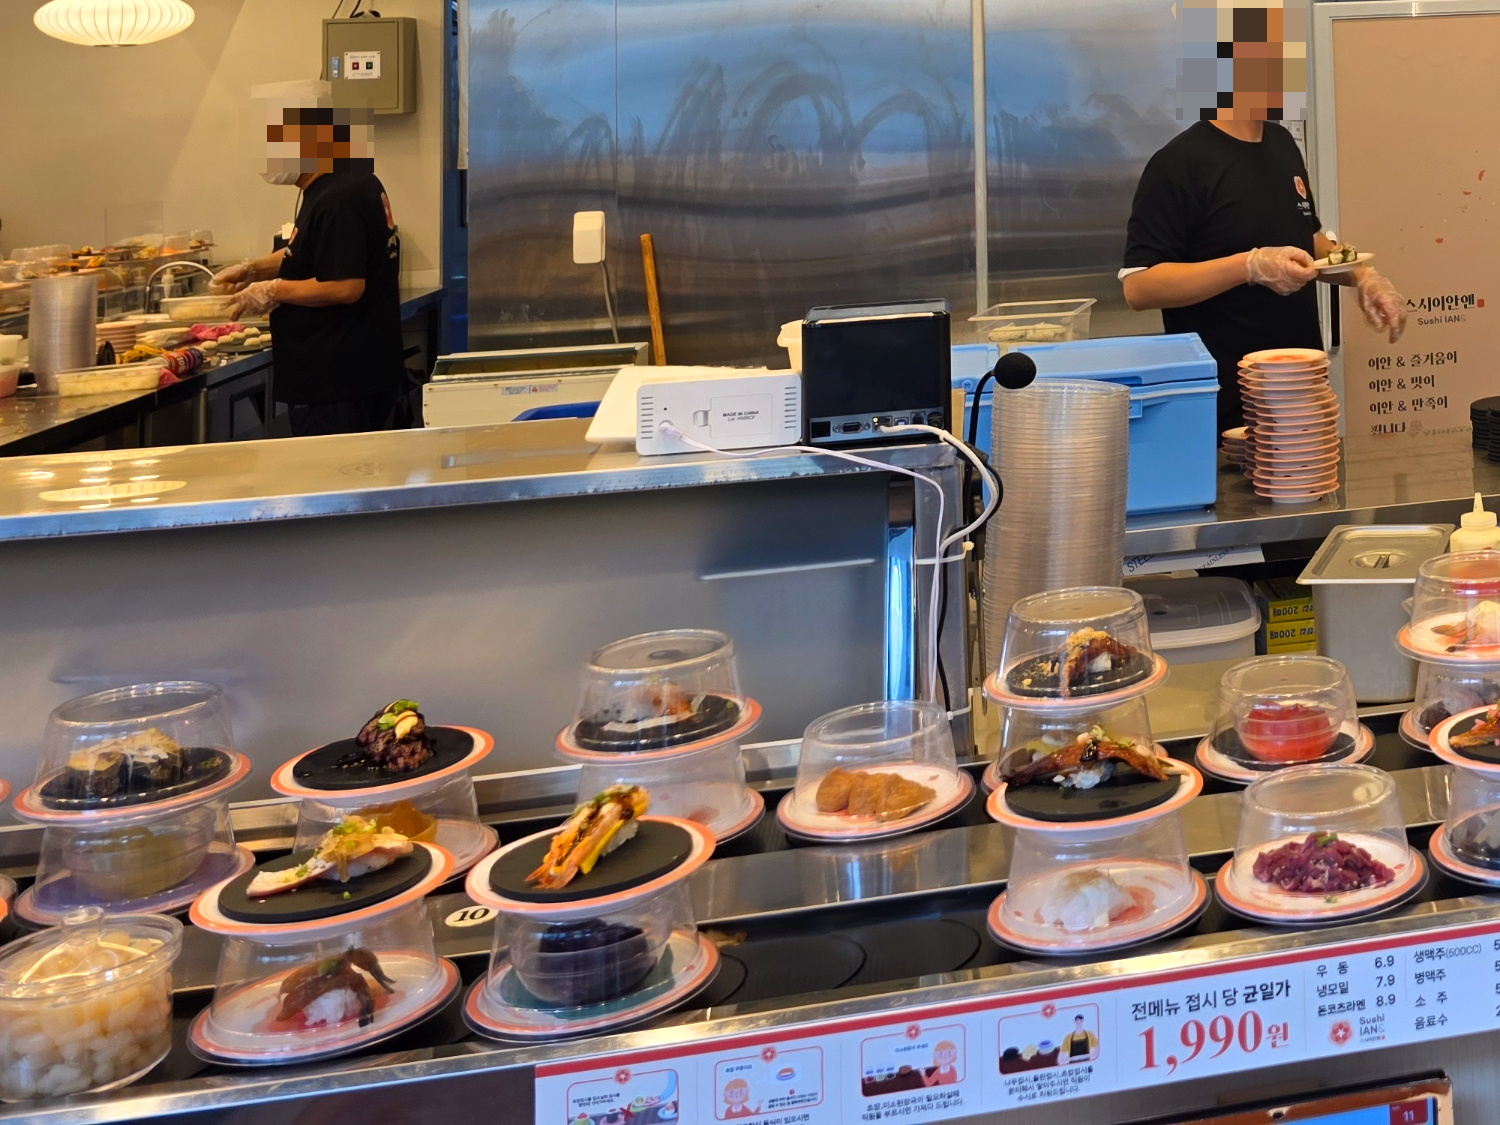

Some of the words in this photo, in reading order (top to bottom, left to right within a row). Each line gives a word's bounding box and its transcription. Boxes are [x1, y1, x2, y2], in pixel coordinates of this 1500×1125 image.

[1406, 293, 1476, 313] 스시이안앤
[1417, 315, 1443, 326] Sushi
[1368, 356, 1392, 371] 이안
[1396, 355, 1406, 368] &
[1409, 350, 1458, 368] 즐거움이
[1368, 378, 1393, 393] 이안
[1396, 378, 1406, 390] &
[1411, 374, 1435, 390] 맛이
[1369, 400, 1394, 415] 이안
[1397, 400, 1407, 412] &
[1412, 395, 1448, 412] 만족이
[1270, 629, 1295, 639] 200매
[453, 908, 491, 923] 10
[1316, 964, 1328, 977] 우
[1337, 961, 1349, 975] 동
[1374, 955, 1395, 970] 6.9
[1316, 981, 1350, 998] 냉모밀
[1375, 974, 1396, 989] 7.9
[1414, 968, 1447, 985] 병맥주
[1131, 998, 1181, 1021] 전메뉴
[1185, 990, 1218, 1013] 접시
[1221, 987, 1239, 1007] 당
[1242, 979, 1291, 1004] 균일가
[1317, 998, 1367, 1017] 돈코츠라멘
[1375, 993, 1397, 1007] 8.9
[1415, 994, 1427, 1008] 소
[1436, 991, 1449, 1005] 주
[1359, 1013, 1385, 1024] Sushi
[1414, 1012, 1449, 1030] 음료수
[1137, 1010, 1263, 1076] 1,990
[1265, 1022, 1290, 1049] 원
[1403, 1110, 1414, 1122] 11
